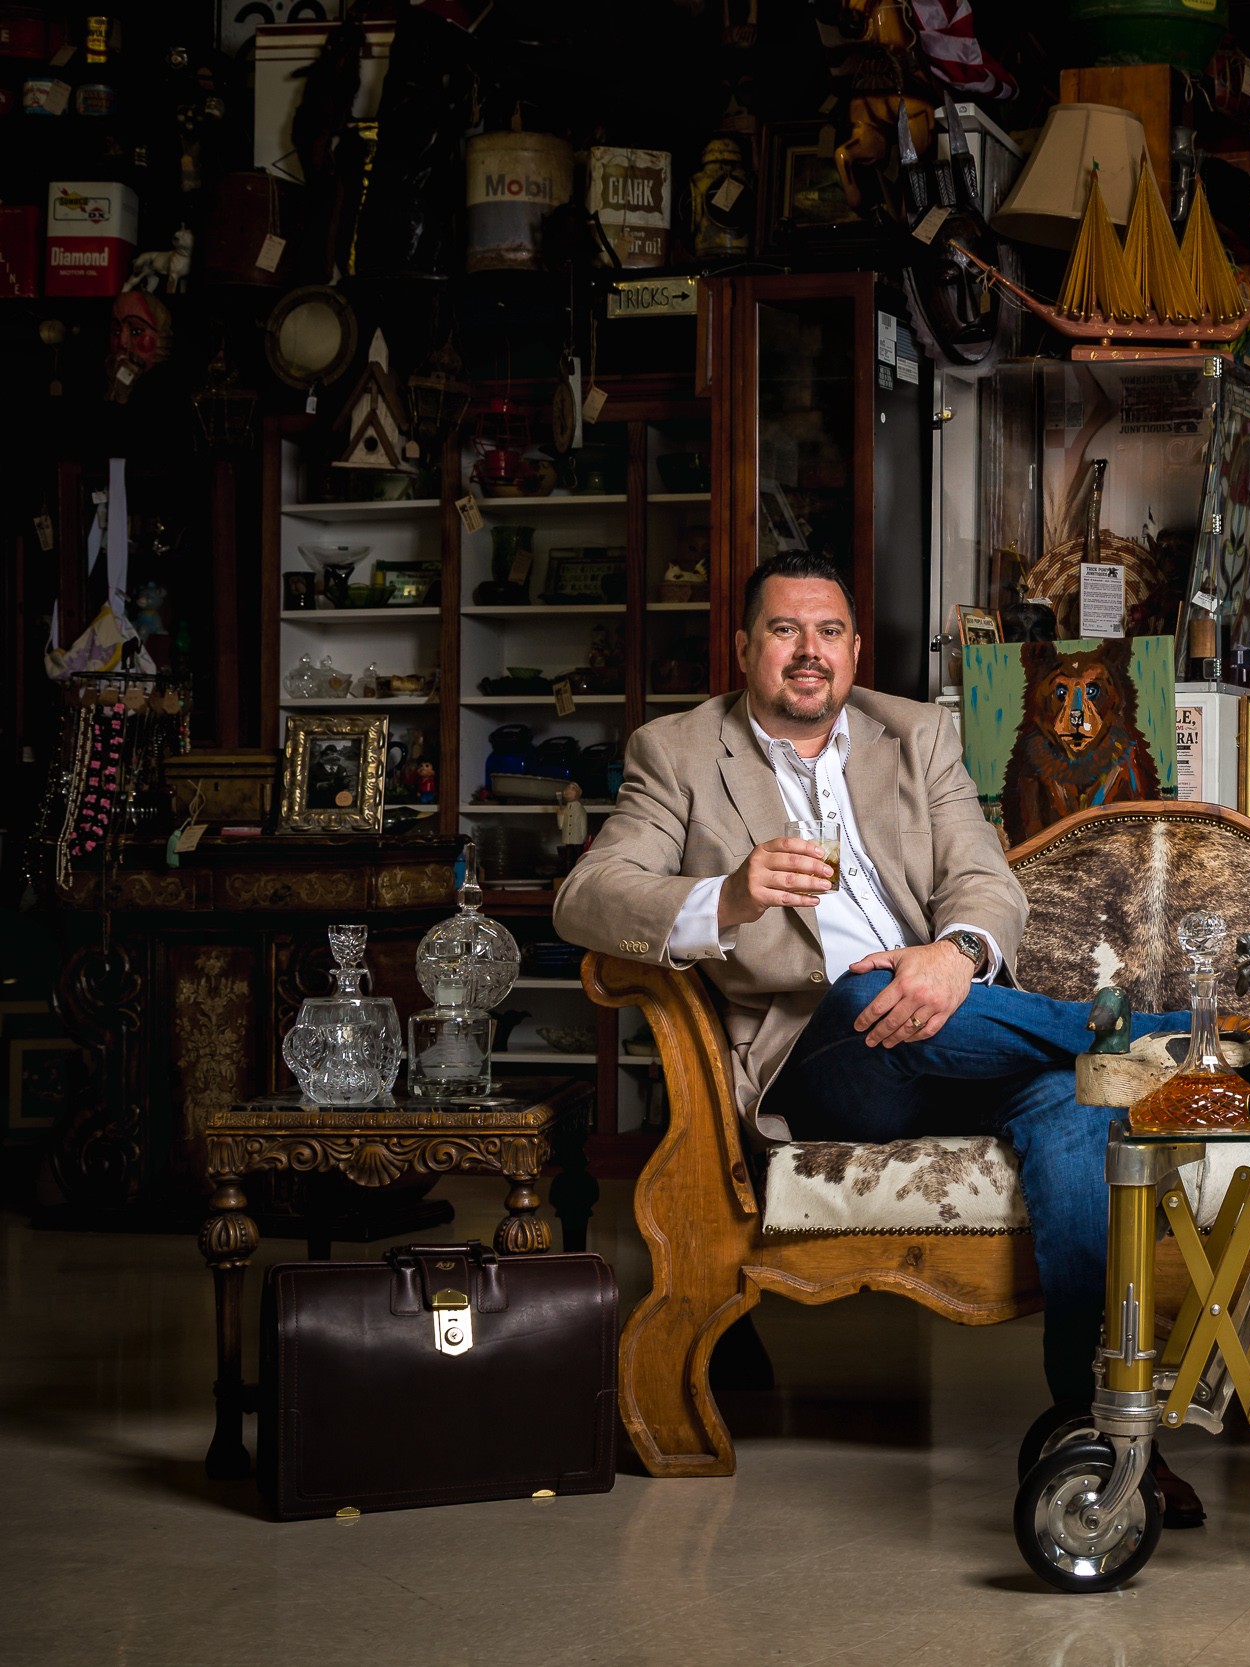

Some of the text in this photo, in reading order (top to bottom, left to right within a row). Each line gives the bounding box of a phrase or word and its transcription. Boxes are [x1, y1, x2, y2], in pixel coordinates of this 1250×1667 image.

[485, 174, 553, 199] Mobil
[608, 176, 655, 207] CLARK
[59, 197, 88, 206] SUNOCO
[50, 246, 109, 267] Diamond
[645, 238, 662, 256] oil
[59, 269, 98, 277] MOTOR OIL
[618, 287, 669, 309] TRICKS
